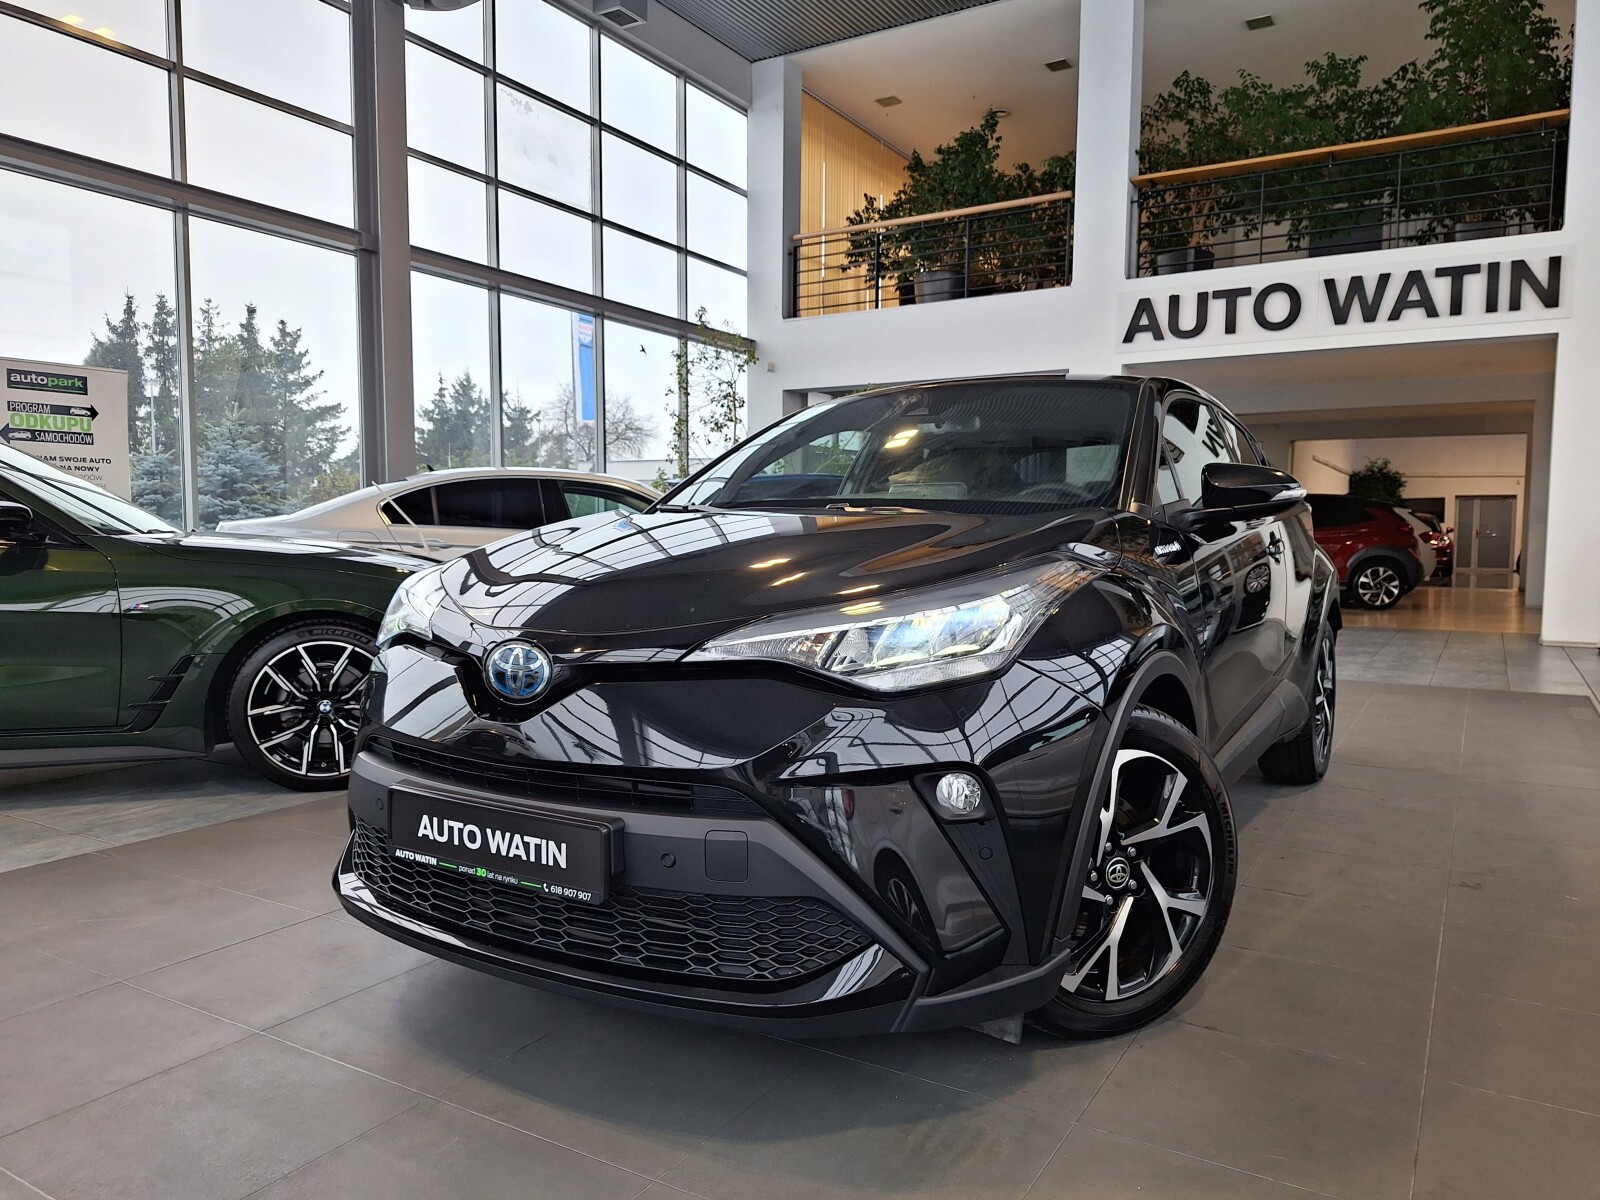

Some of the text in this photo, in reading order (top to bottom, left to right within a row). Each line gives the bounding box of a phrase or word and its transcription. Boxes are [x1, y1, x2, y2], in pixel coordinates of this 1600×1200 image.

[1122, 255, 1562, 343] AUTO WATIN
[10, 373, 84, 388] autopark
[9, 402, 51, 413] PROGRAM
[9, 412, 92, 432] ODKUPU
[35, 431, 93, 444] SAMOCHODÓW
[312, 629, 369, 642] MICHELIN
[417, 814, 567, 869] AUTO WATIN
[1220, 802, 1234, 875] MICHELIN
[395, 849, 437, 866] AUTO WATIN
[458, 865, 475, 875] ponad
[476, 867, 487, 877] 30
[487, 870, 495, 879] lat
[503, 875, 518, 884] rynku
[550, 885, 592, 901] 618 907 907
